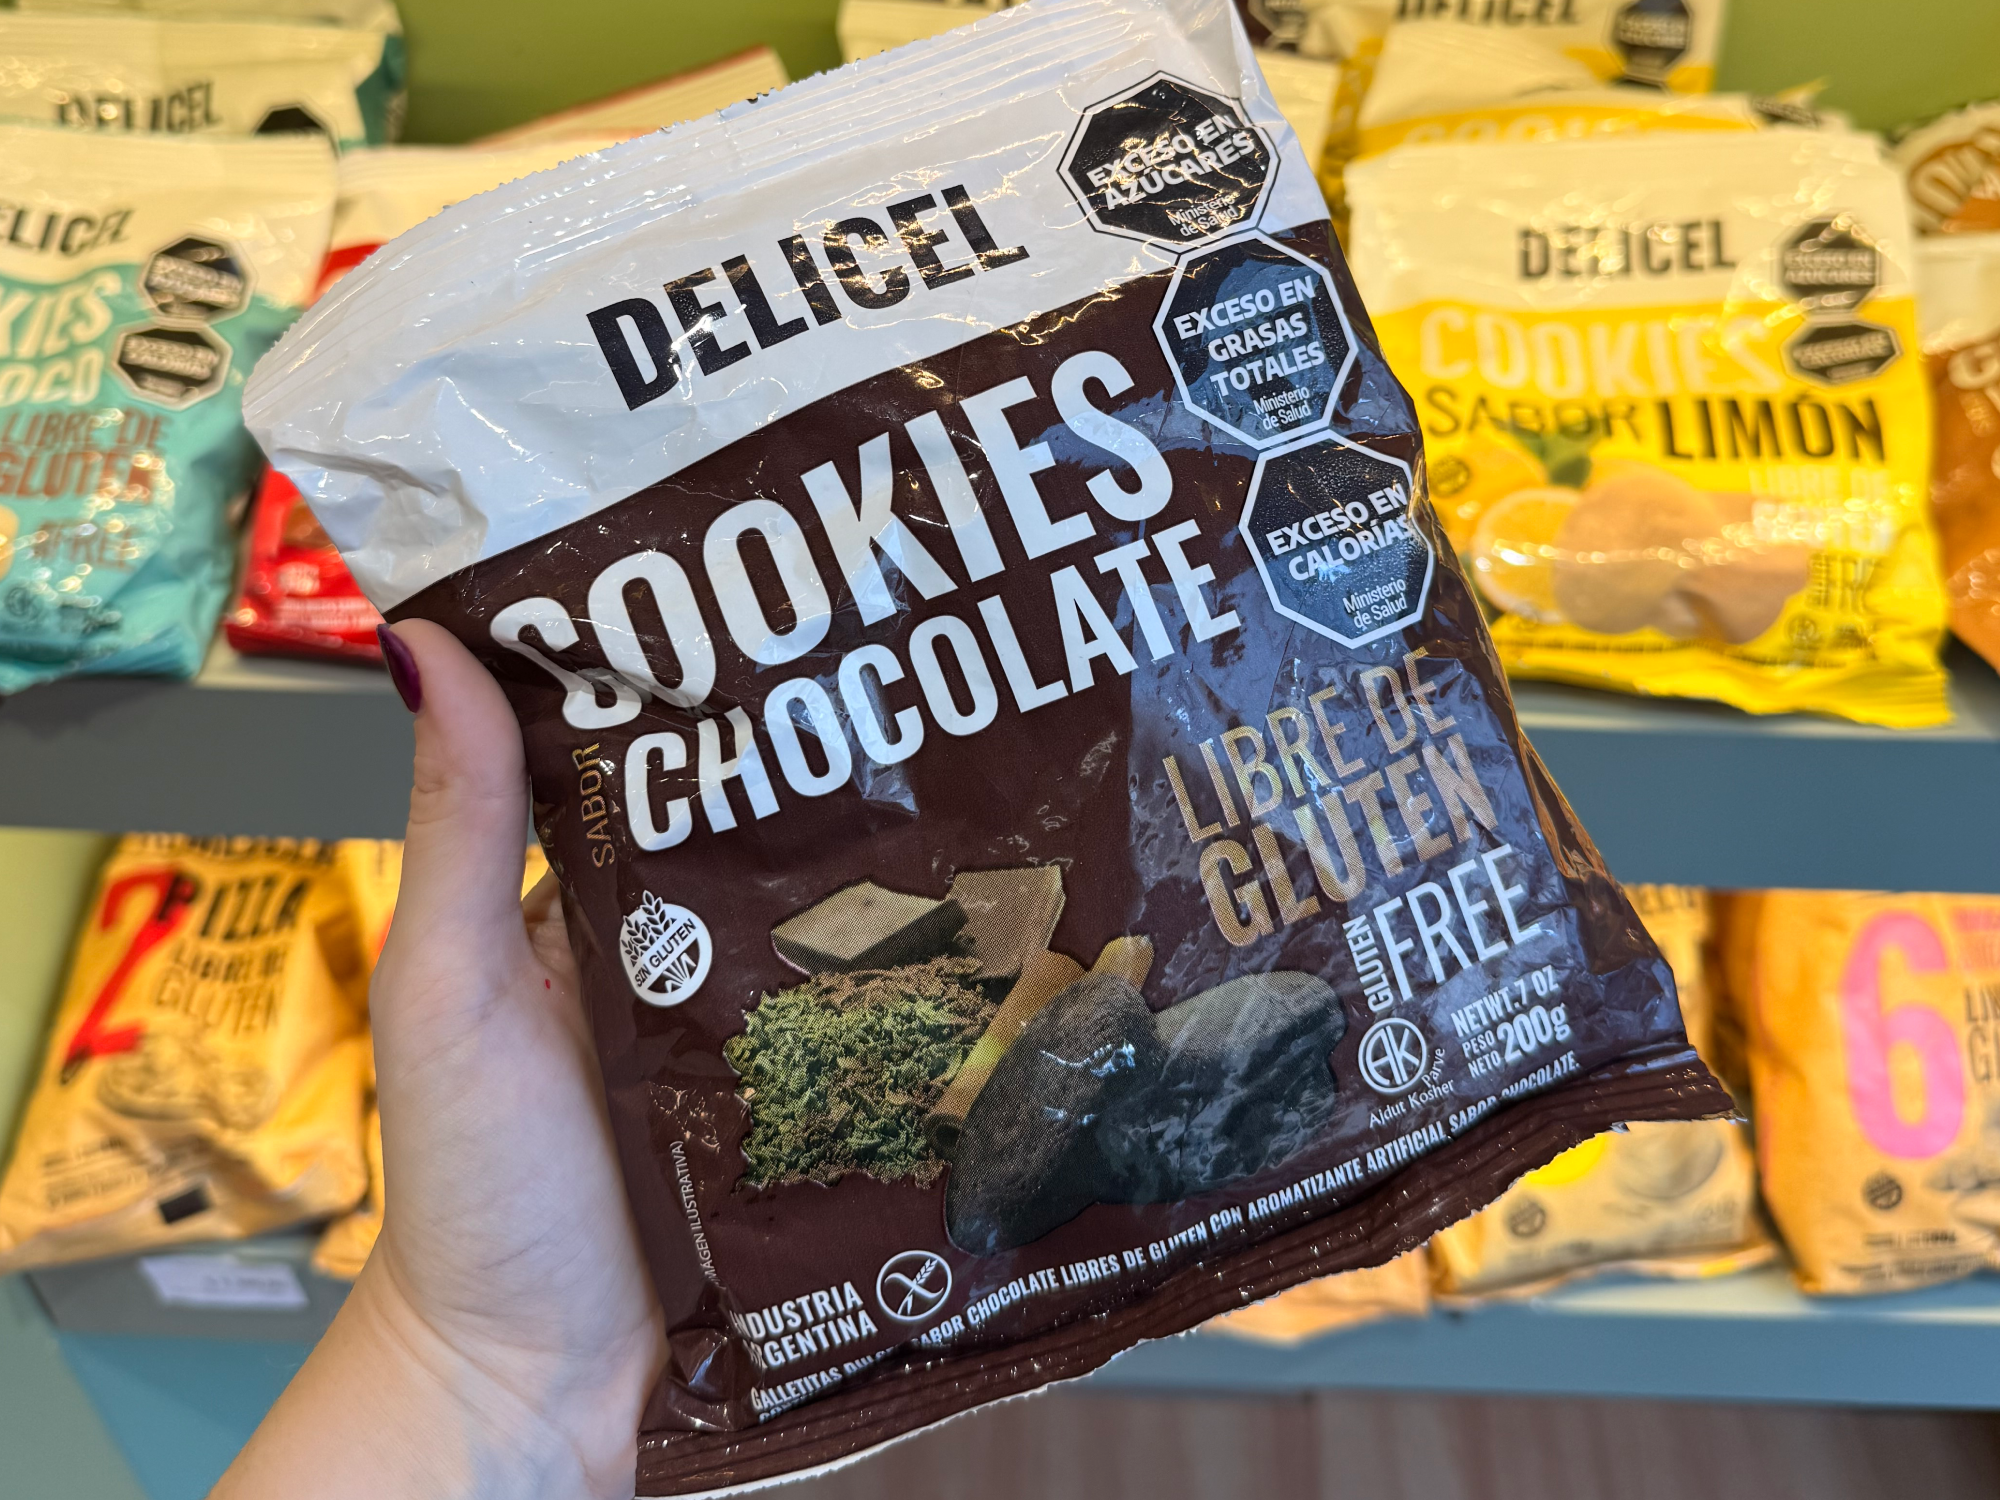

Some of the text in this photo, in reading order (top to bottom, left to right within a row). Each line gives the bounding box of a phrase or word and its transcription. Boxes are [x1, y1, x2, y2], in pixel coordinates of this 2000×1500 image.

[1086, 115, 1241, 188] EXCESO EN
[586, 184, 1030, 411] DELICEL
[1173, 275, 1316, 340] EXCESO EN
[1208, 313, 1308, 362] GRASAS
[1210, 341, 1325, 396] TOTALES
[1418, 306, 1784, 399] COOKIES
[1253, 385, 1310, 416] Ministerio
[1262, 402, 1311, 431] de Salud
[1654, 388, 1886, 463] LIMÓN
[1266, 483, 1408, 556] EXCESO EN
[1288, 514, 1412, 581] CALORÍAS
[1342, 577, 1406, 613] Ministerio
[1353, 593, 1408, 629] de Salud
[624, 519, 1241, 852] CHOCOLATE
[1162, 646, 1457, 843] LIBRE DE
[572, 742, 615, 868] SABOR
[1199, 732, 1499, 947] GLUTEN
[634, 917, 697, 988] SIN GLUTEN
[1373, 843, 1546, 1003] FREE
[1342, 914, 1394, 1014] GLUTEN
[1531, 964, 1560, 997] OZ
[1422, 1047, 1445, 1087] Parve
[1462, 1030, 1495, 1058] PESO
[1467, 1050, 1500, 1079] NETO
[1496, 1002, 1572, 1063] 200g
[1840, 908, 1964, 1159] 6
[1369, 1079, 1454, 1129] Ajdut Kosher
[669, 1140, 702, 1230] ILUSTRATIVA)
[751, 1366, 843, 1411] GALLETITAS
[967, 1268, 1059, 1327] CHOCOLATE
[1059, 1254, 1121, 1286] LIBRES
[1123, 1246, 1147, 1268] DE
[1149, 1222, 1208, 1262] GLUTEN
[1209, 1206, 1243, 1233] CON
[1248, 1157, 1364, 1221] AROMATIZANTE
[1365, 1119, 1448, 1174] ARTIFICIAL
